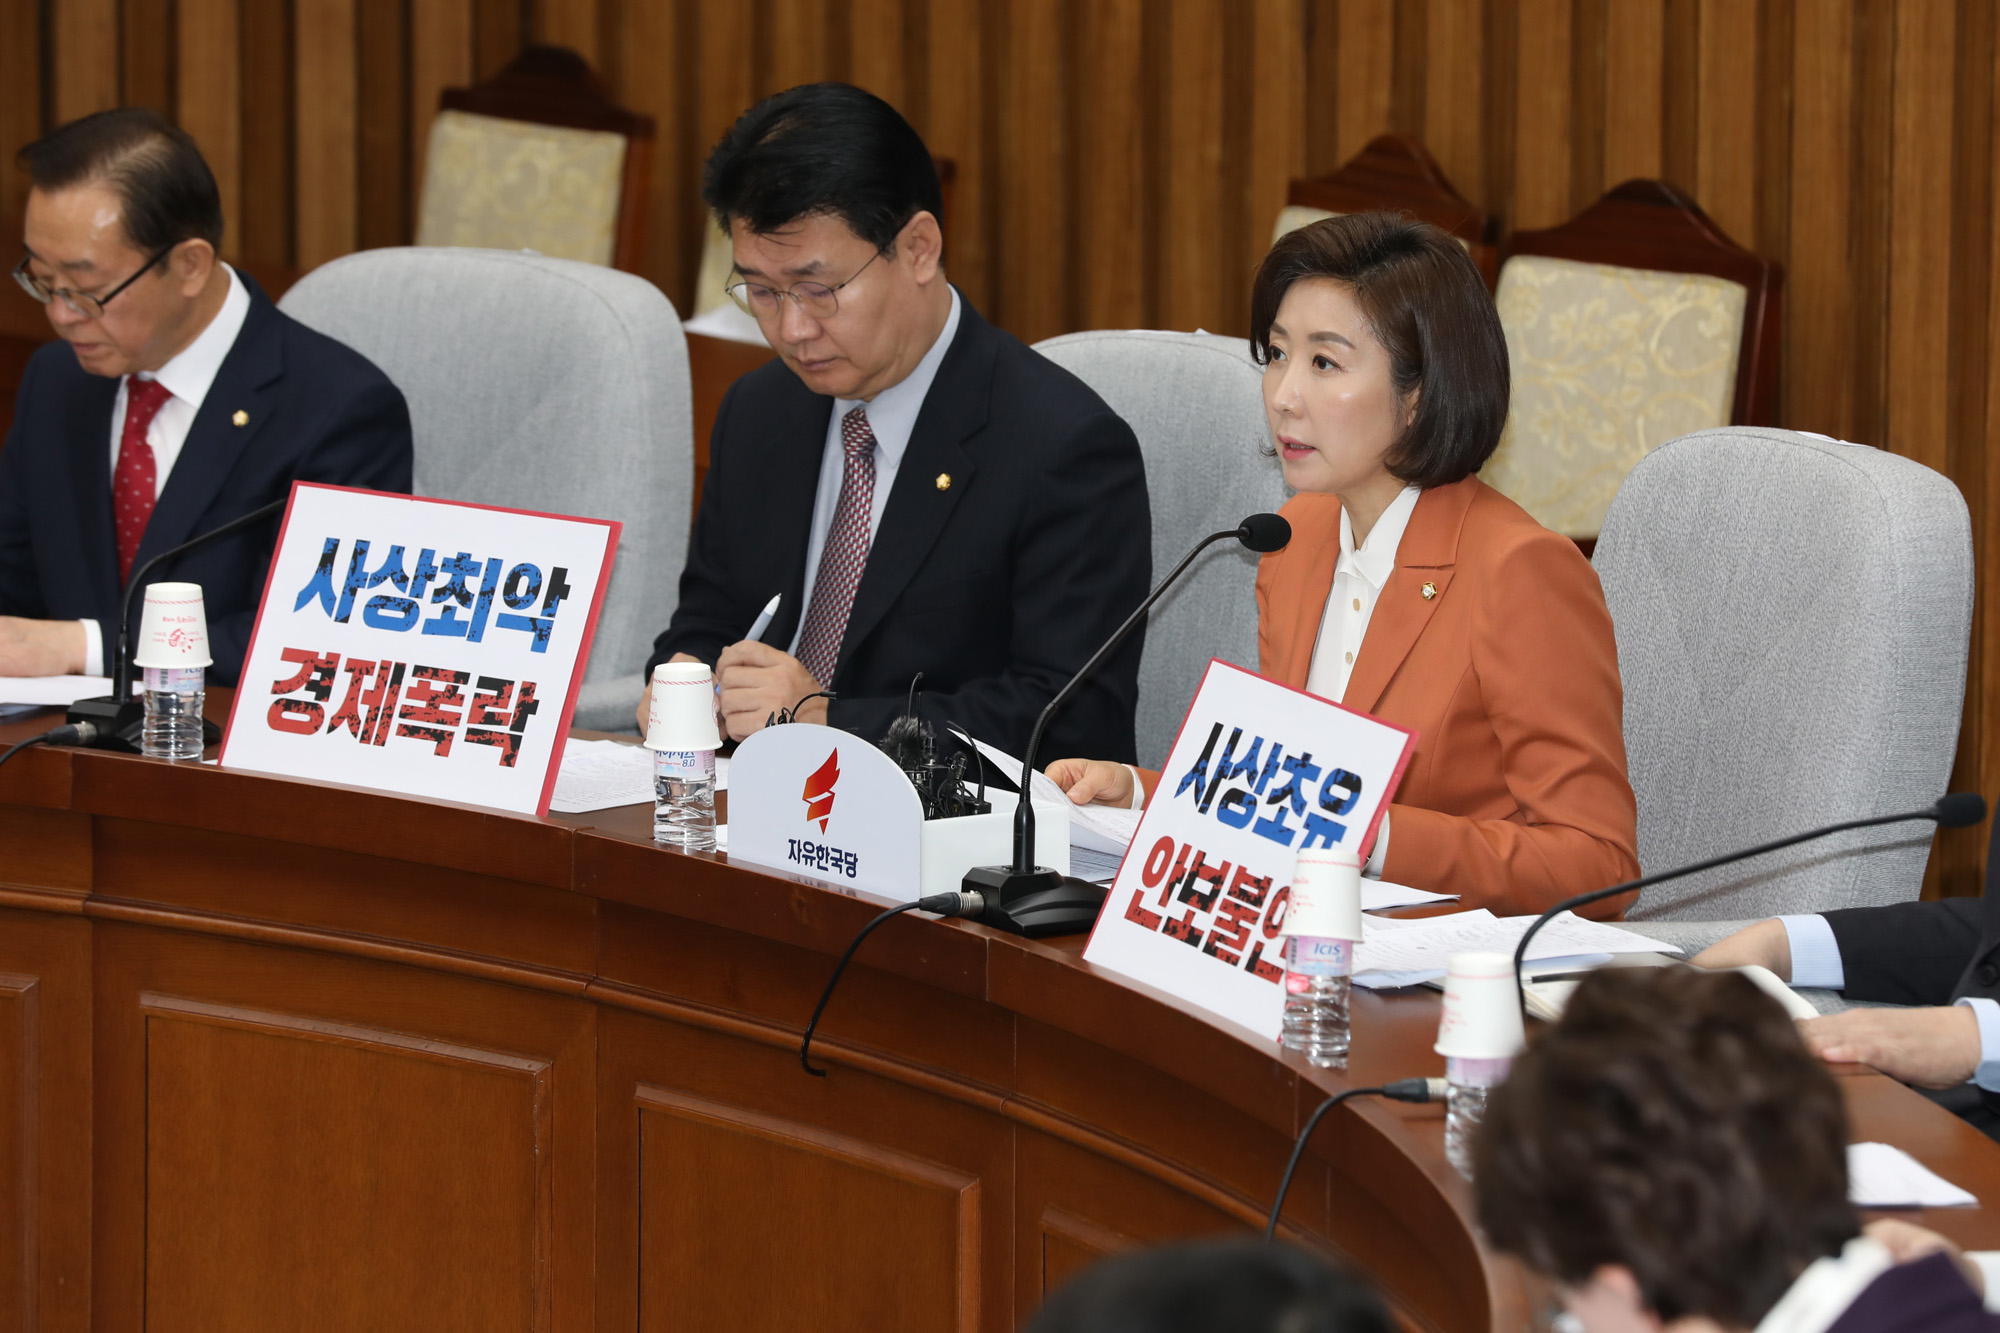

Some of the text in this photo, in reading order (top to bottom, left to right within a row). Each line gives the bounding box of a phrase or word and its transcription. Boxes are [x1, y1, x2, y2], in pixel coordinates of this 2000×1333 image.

[293, 537, 571, 654] 사상최악
[266, 647, 540, 768] 경제폭락
[682, 759, 695, 767] 8.0
[1173, 721, 1363, 854] 사상초유
[787, 838, 859, 878] 자유한국당
